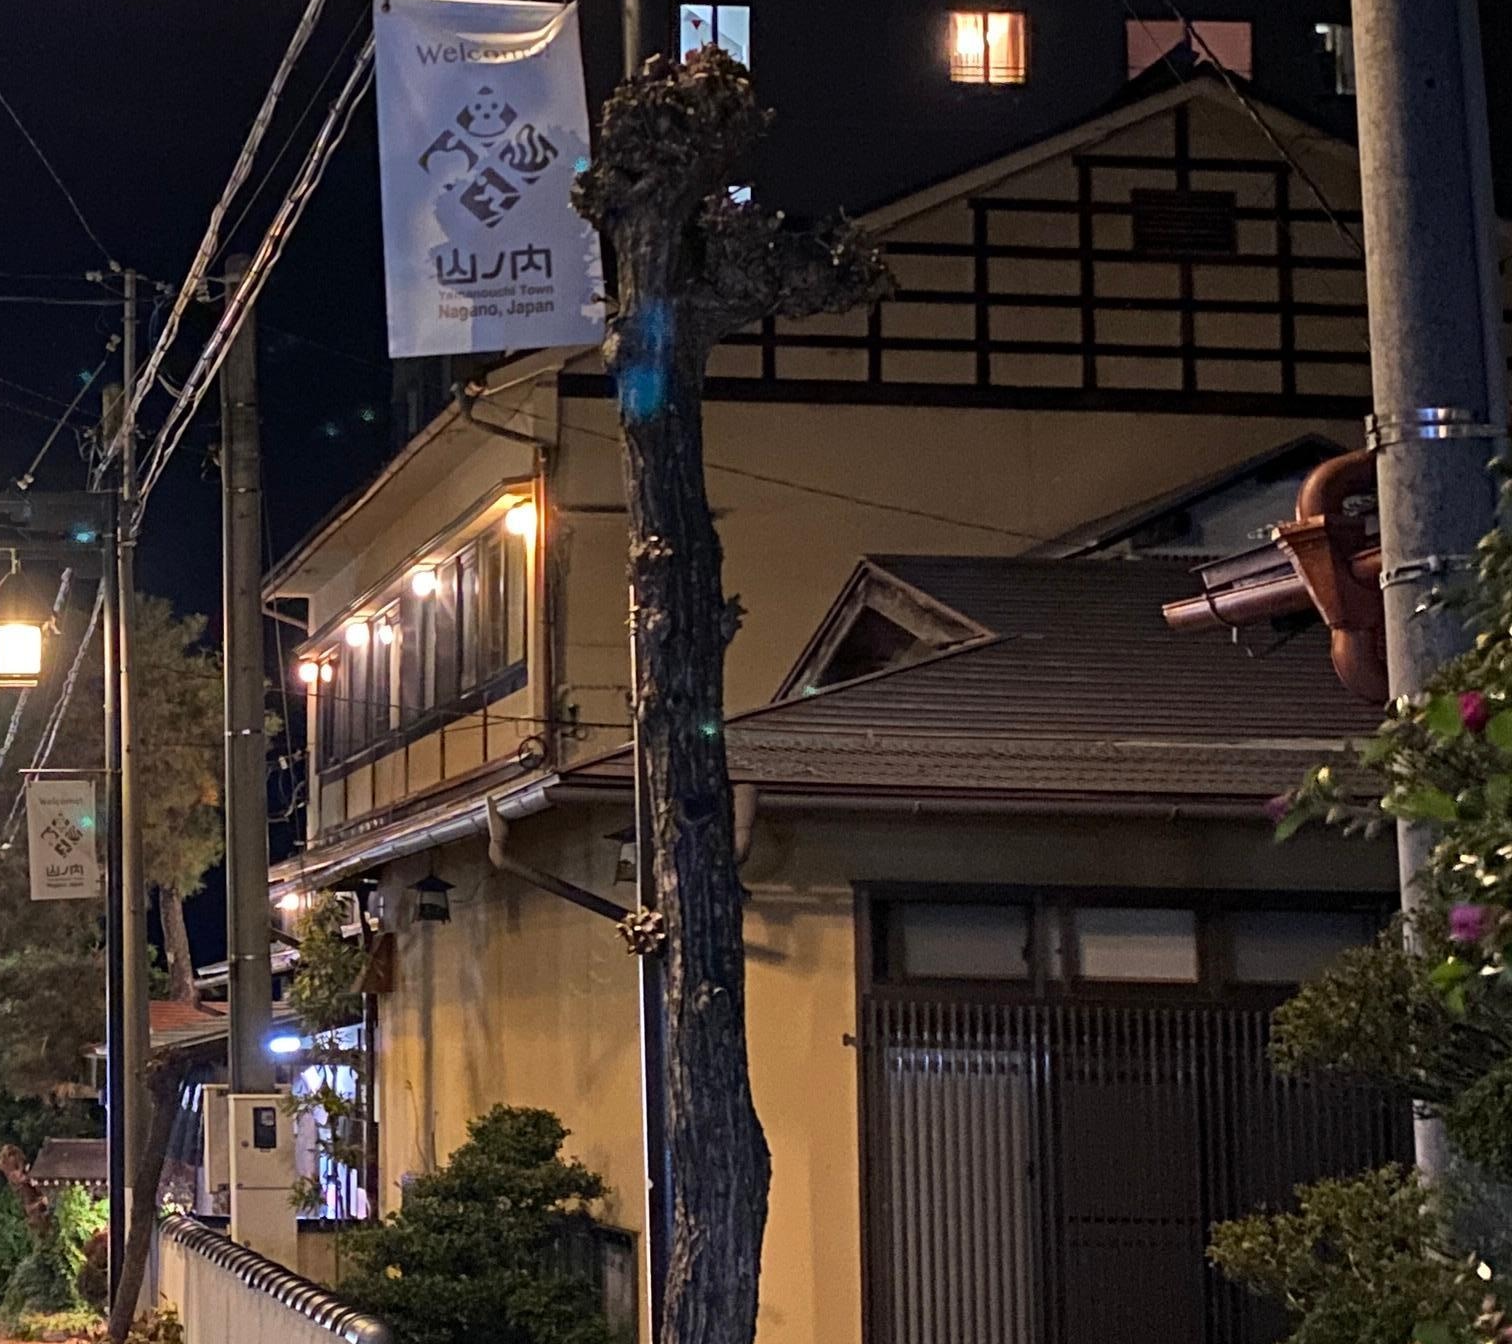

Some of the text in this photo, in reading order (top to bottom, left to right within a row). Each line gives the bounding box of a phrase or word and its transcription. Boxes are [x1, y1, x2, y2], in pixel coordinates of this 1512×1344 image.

[416, 41, 551, 65] Welcom!
[436, 244, 552, 286] 山ノ内
[520, 285, 554, 296] Town
[439, 300, 554, 321] Nagano, Japan
[46, 864, 84, 877] 山ノ内
